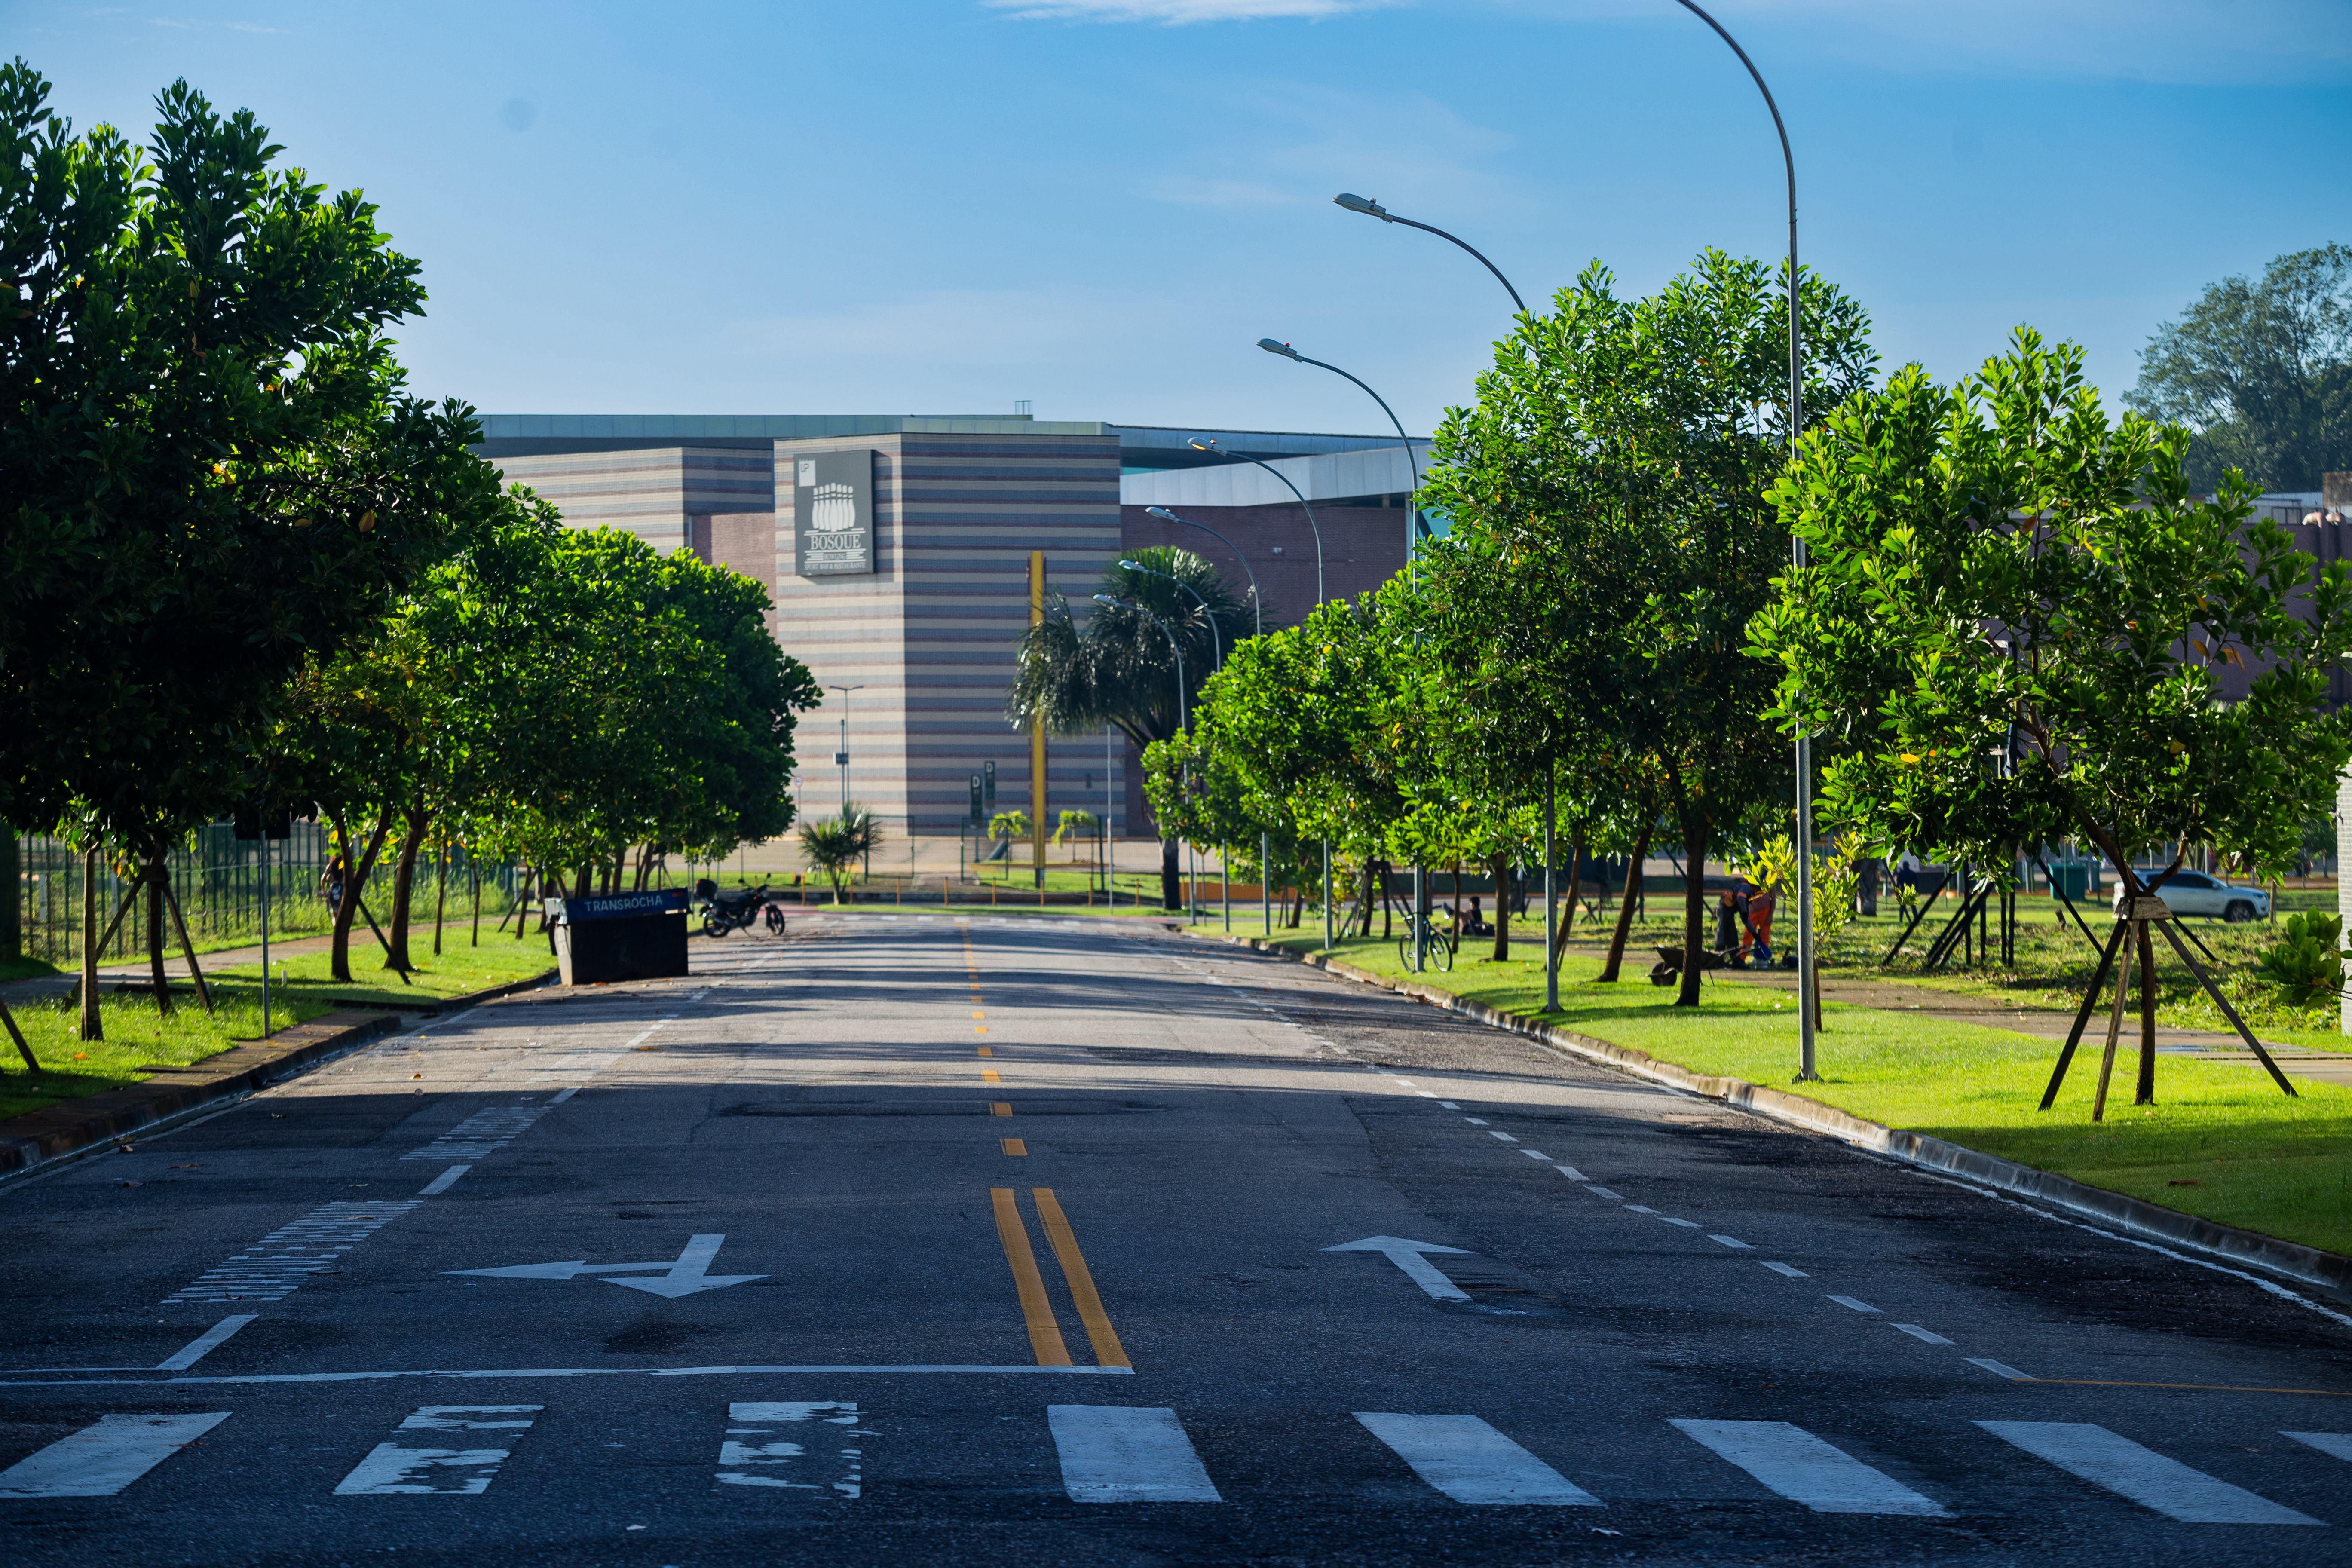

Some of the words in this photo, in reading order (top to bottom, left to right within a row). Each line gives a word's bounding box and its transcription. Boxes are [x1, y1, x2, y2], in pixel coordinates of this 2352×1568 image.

[810, 534, 861, 550] BOSQUE
[986, 762, 993, 773] D
[972, 776, 980, 788] D
[584, 895, 663, 912] TRANSROCHA
